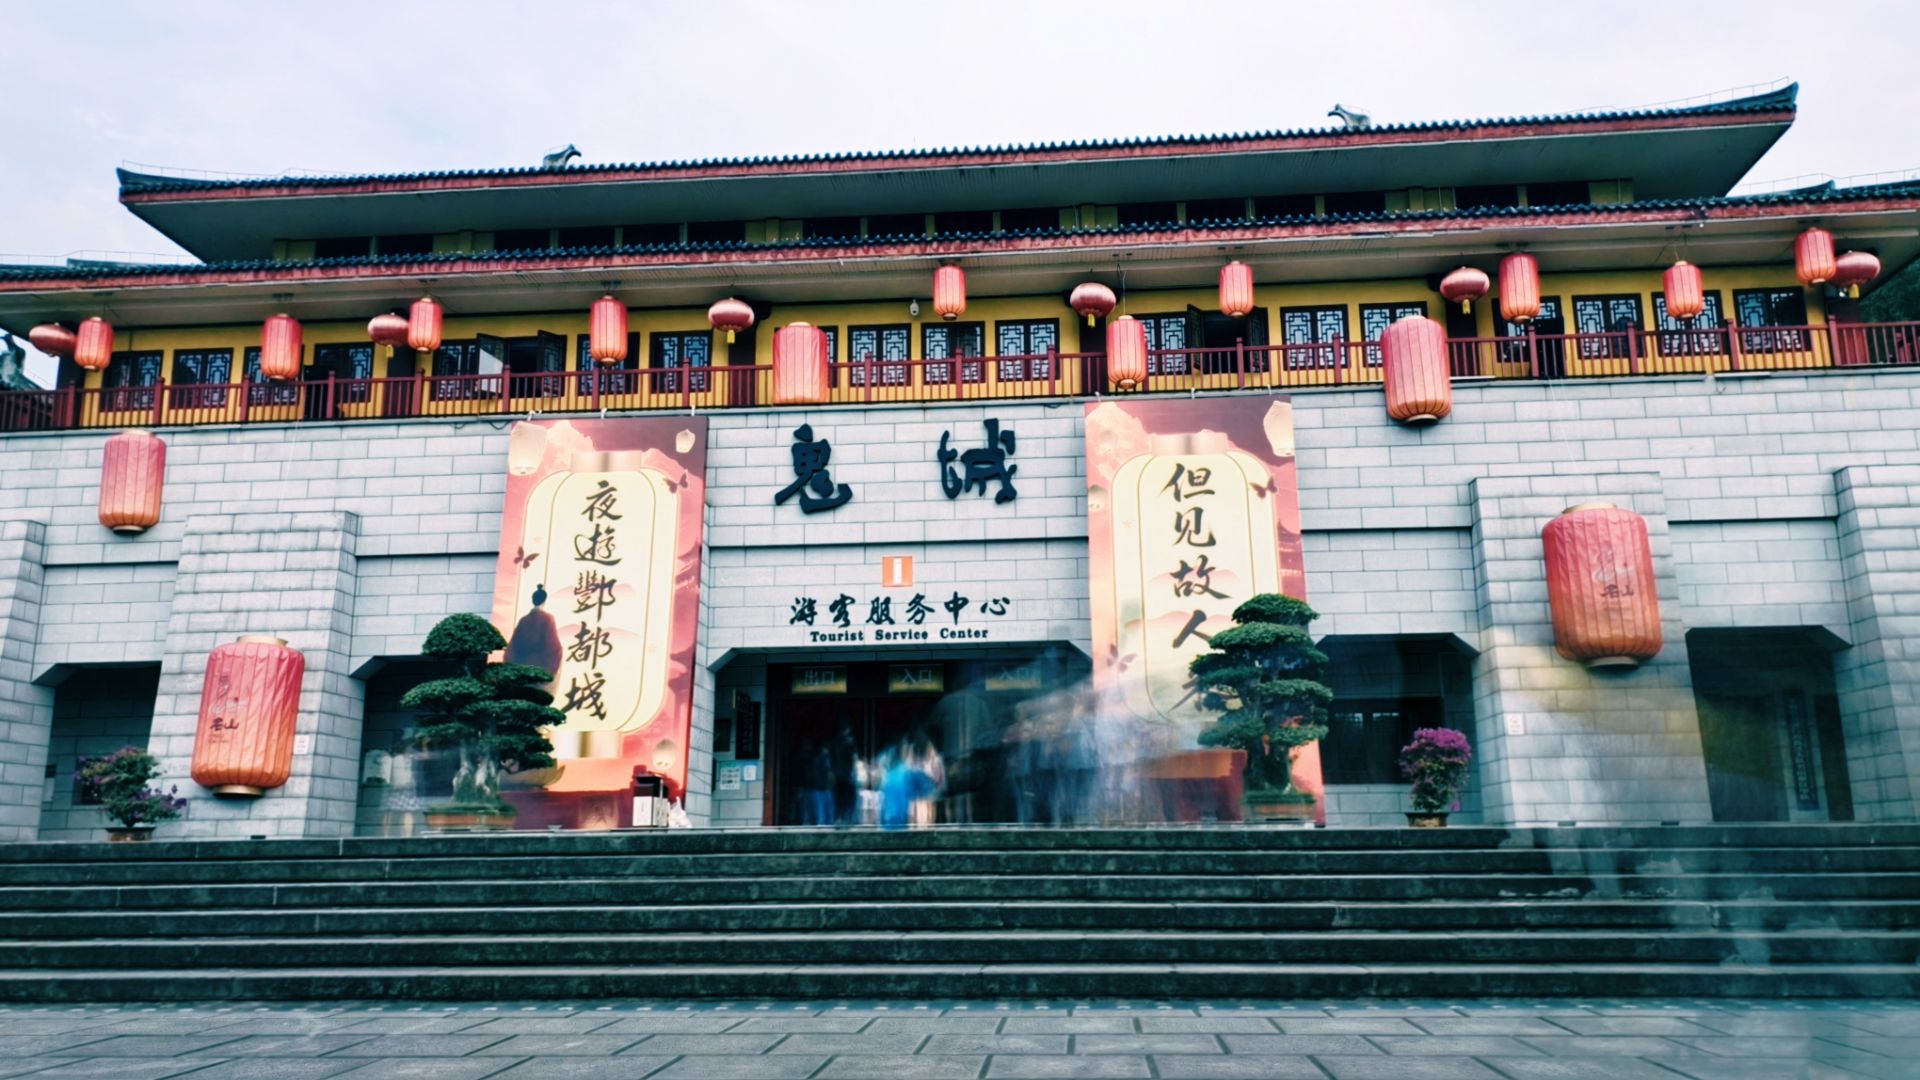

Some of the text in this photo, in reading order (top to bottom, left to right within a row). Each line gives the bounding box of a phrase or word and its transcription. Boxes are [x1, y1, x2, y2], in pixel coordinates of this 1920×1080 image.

[774, 418, 1018, 514] 鬼城
[789, 591, 1011, 628] 游客服务中心
[810, 626, 989, 642] Tourist Service Center
[804, 670, 835, 686] 出口
[901, 668, 932, 684] 入口
